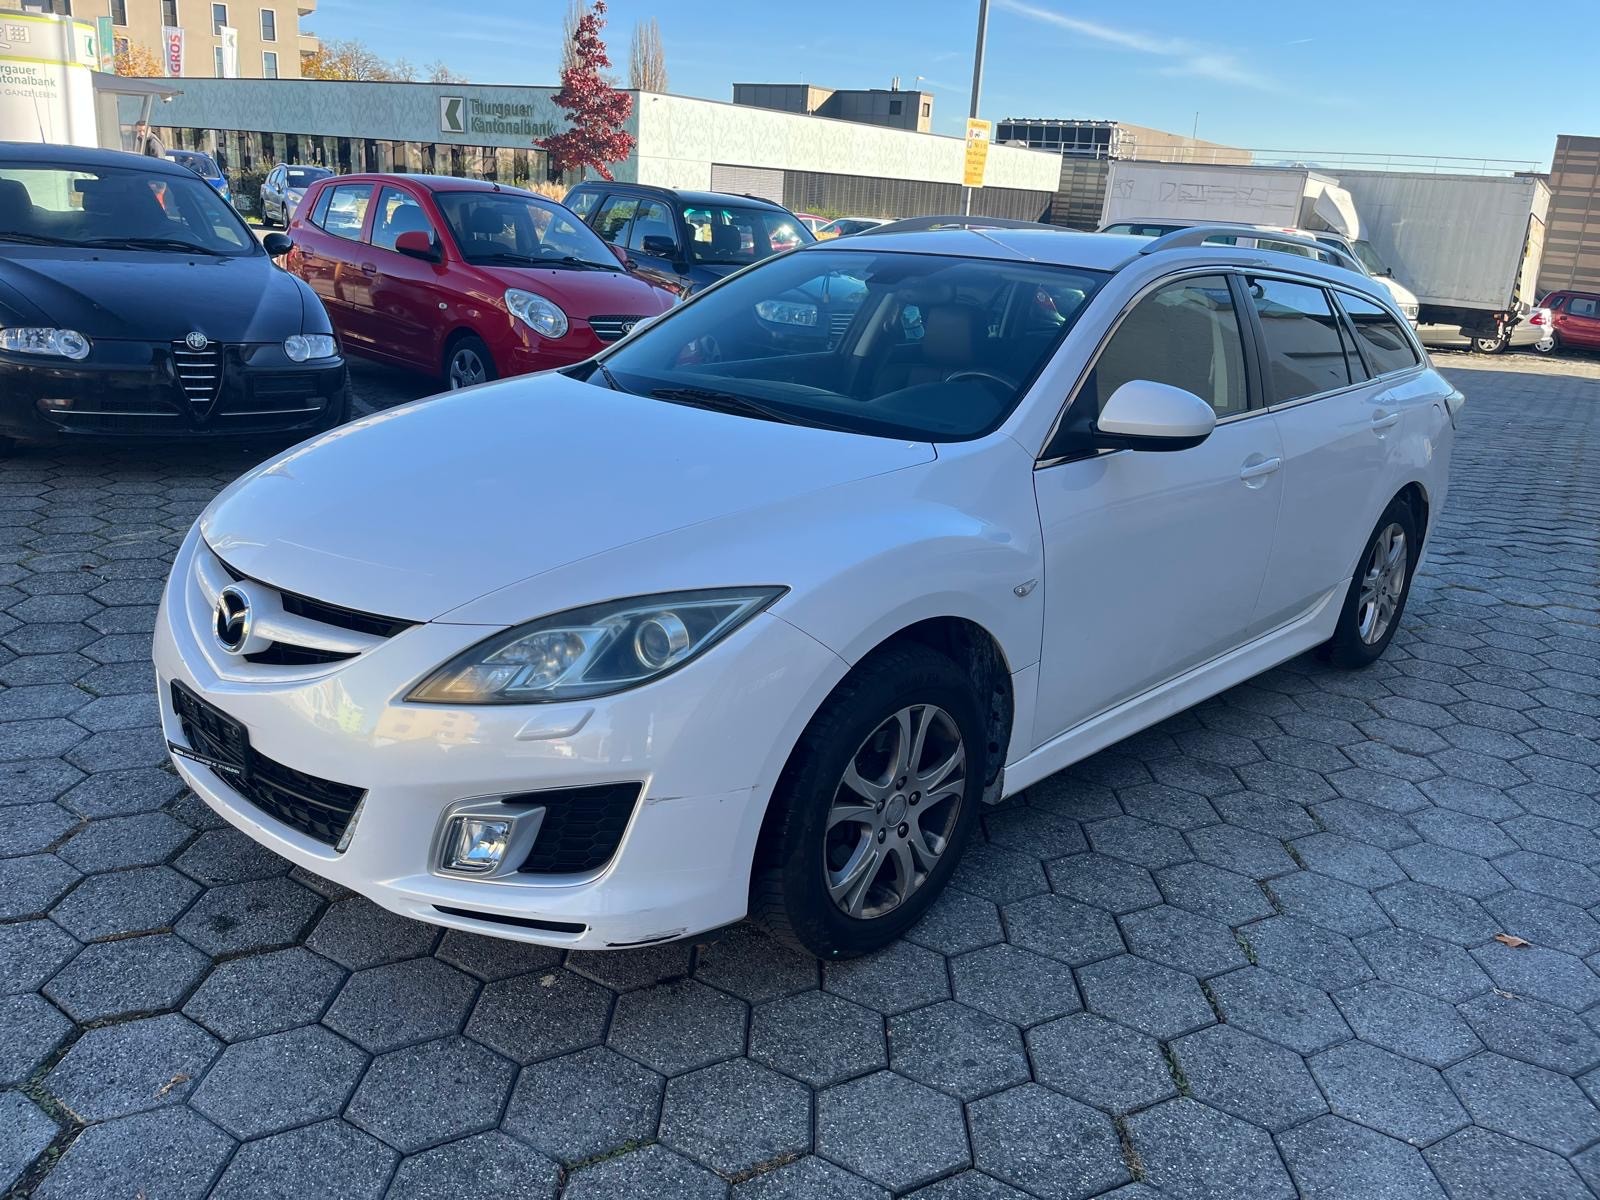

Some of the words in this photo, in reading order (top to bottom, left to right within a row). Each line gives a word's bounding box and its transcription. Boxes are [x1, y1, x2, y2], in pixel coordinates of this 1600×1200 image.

[170, 33, 181, 77] GROS
[470, 98, 534, 119] Thurgauer
[471, 117, 557, 136] Kantonalbank
